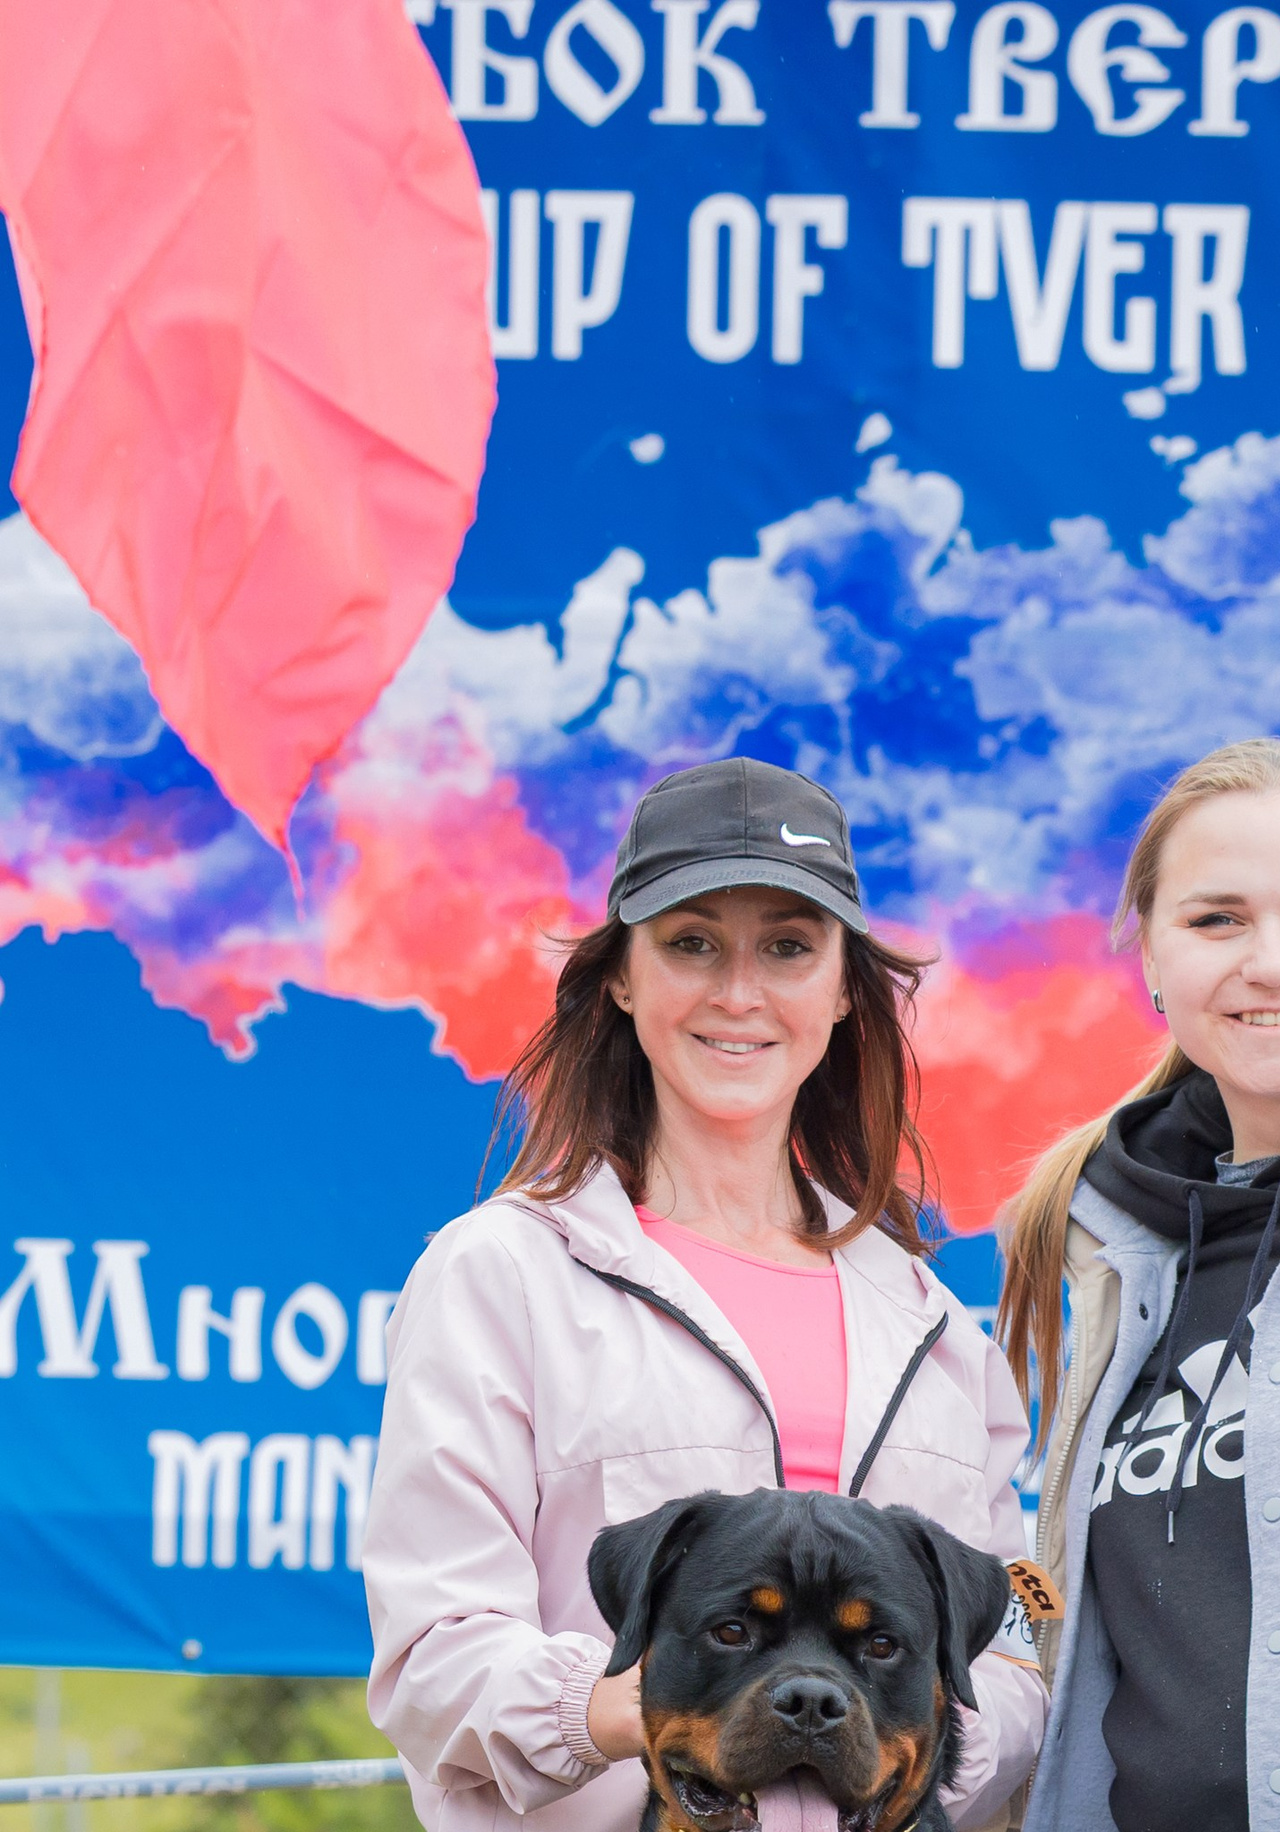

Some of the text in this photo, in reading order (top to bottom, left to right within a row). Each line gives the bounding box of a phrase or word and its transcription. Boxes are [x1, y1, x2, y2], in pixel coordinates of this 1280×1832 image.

[409, 0, 766, 127] БОК
[482, 190, 1251, 378] UP OF TVER
[148, 1430, 380, 1572] MAN
[1005, 1562, 1055, 1611] nta
